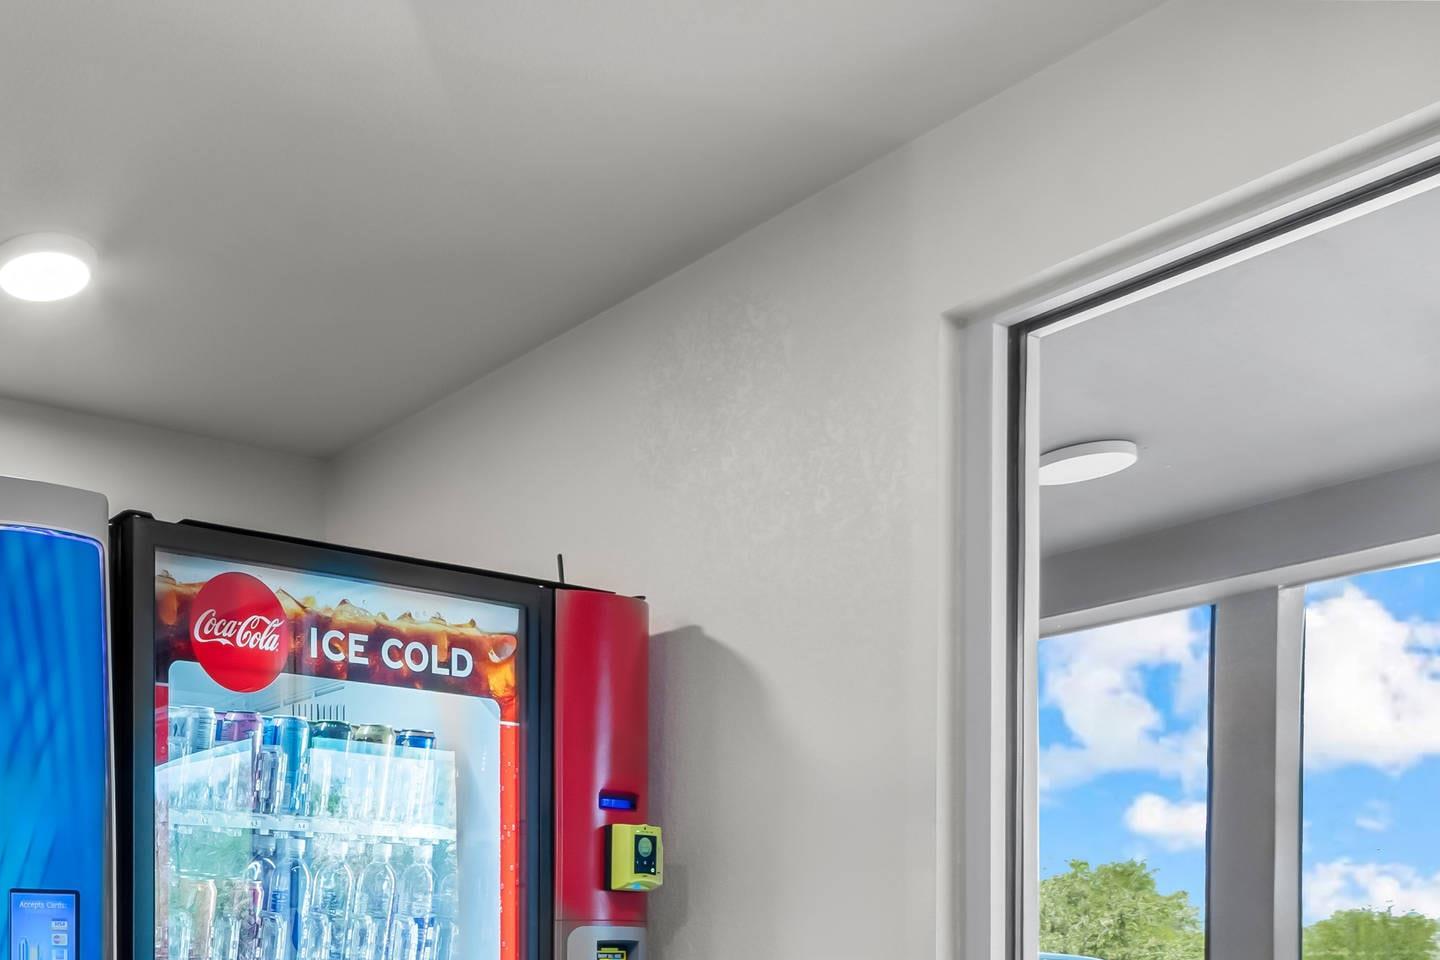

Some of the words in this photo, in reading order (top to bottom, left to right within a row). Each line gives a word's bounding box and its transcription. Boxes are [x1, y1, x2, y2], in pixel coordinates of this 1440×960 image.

[193, 607, 285, 653] Coca-Cola
[310, 625, 370, 665] ICE
[381, 637, 475, 678] COLD
